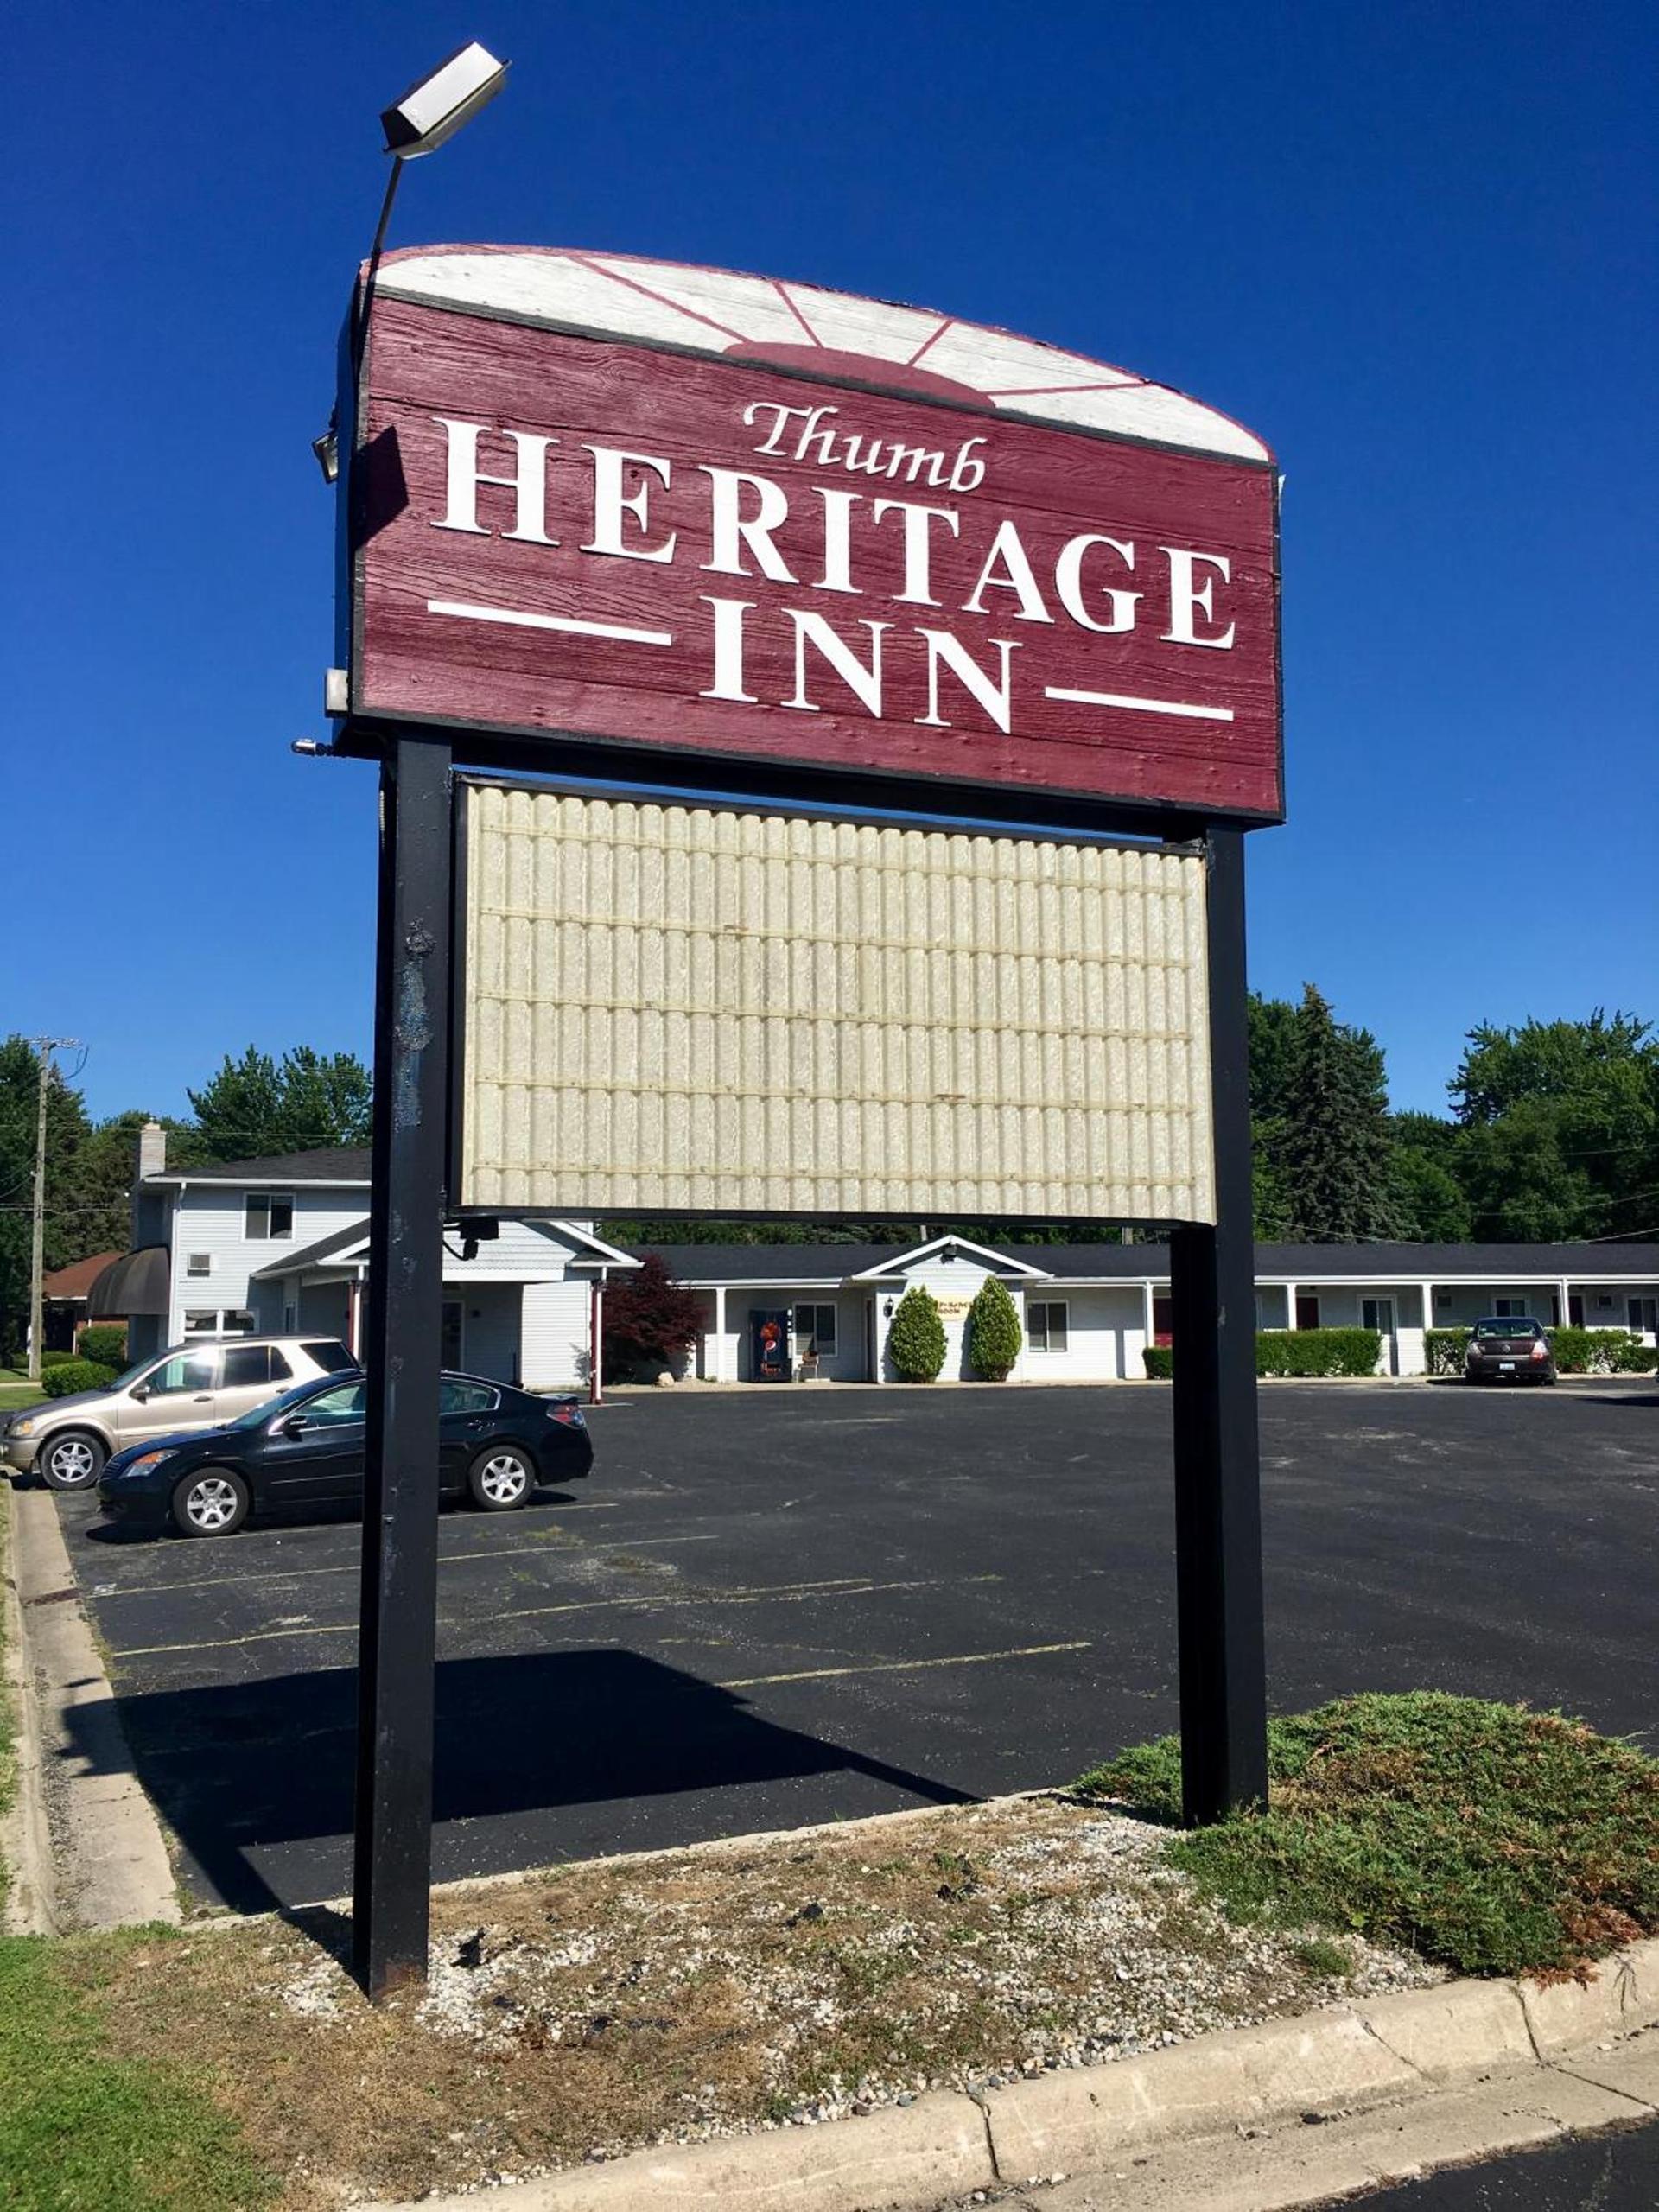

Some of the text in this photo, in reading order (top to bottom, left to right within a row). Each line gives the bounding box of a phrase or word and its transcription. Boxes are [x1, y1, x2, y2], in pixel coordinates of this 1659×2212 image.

[743, 402, 988, 493] Thumb
[430, 417, 1236, 650] HERITAGE
[698, 595, 1023, 734] INN
